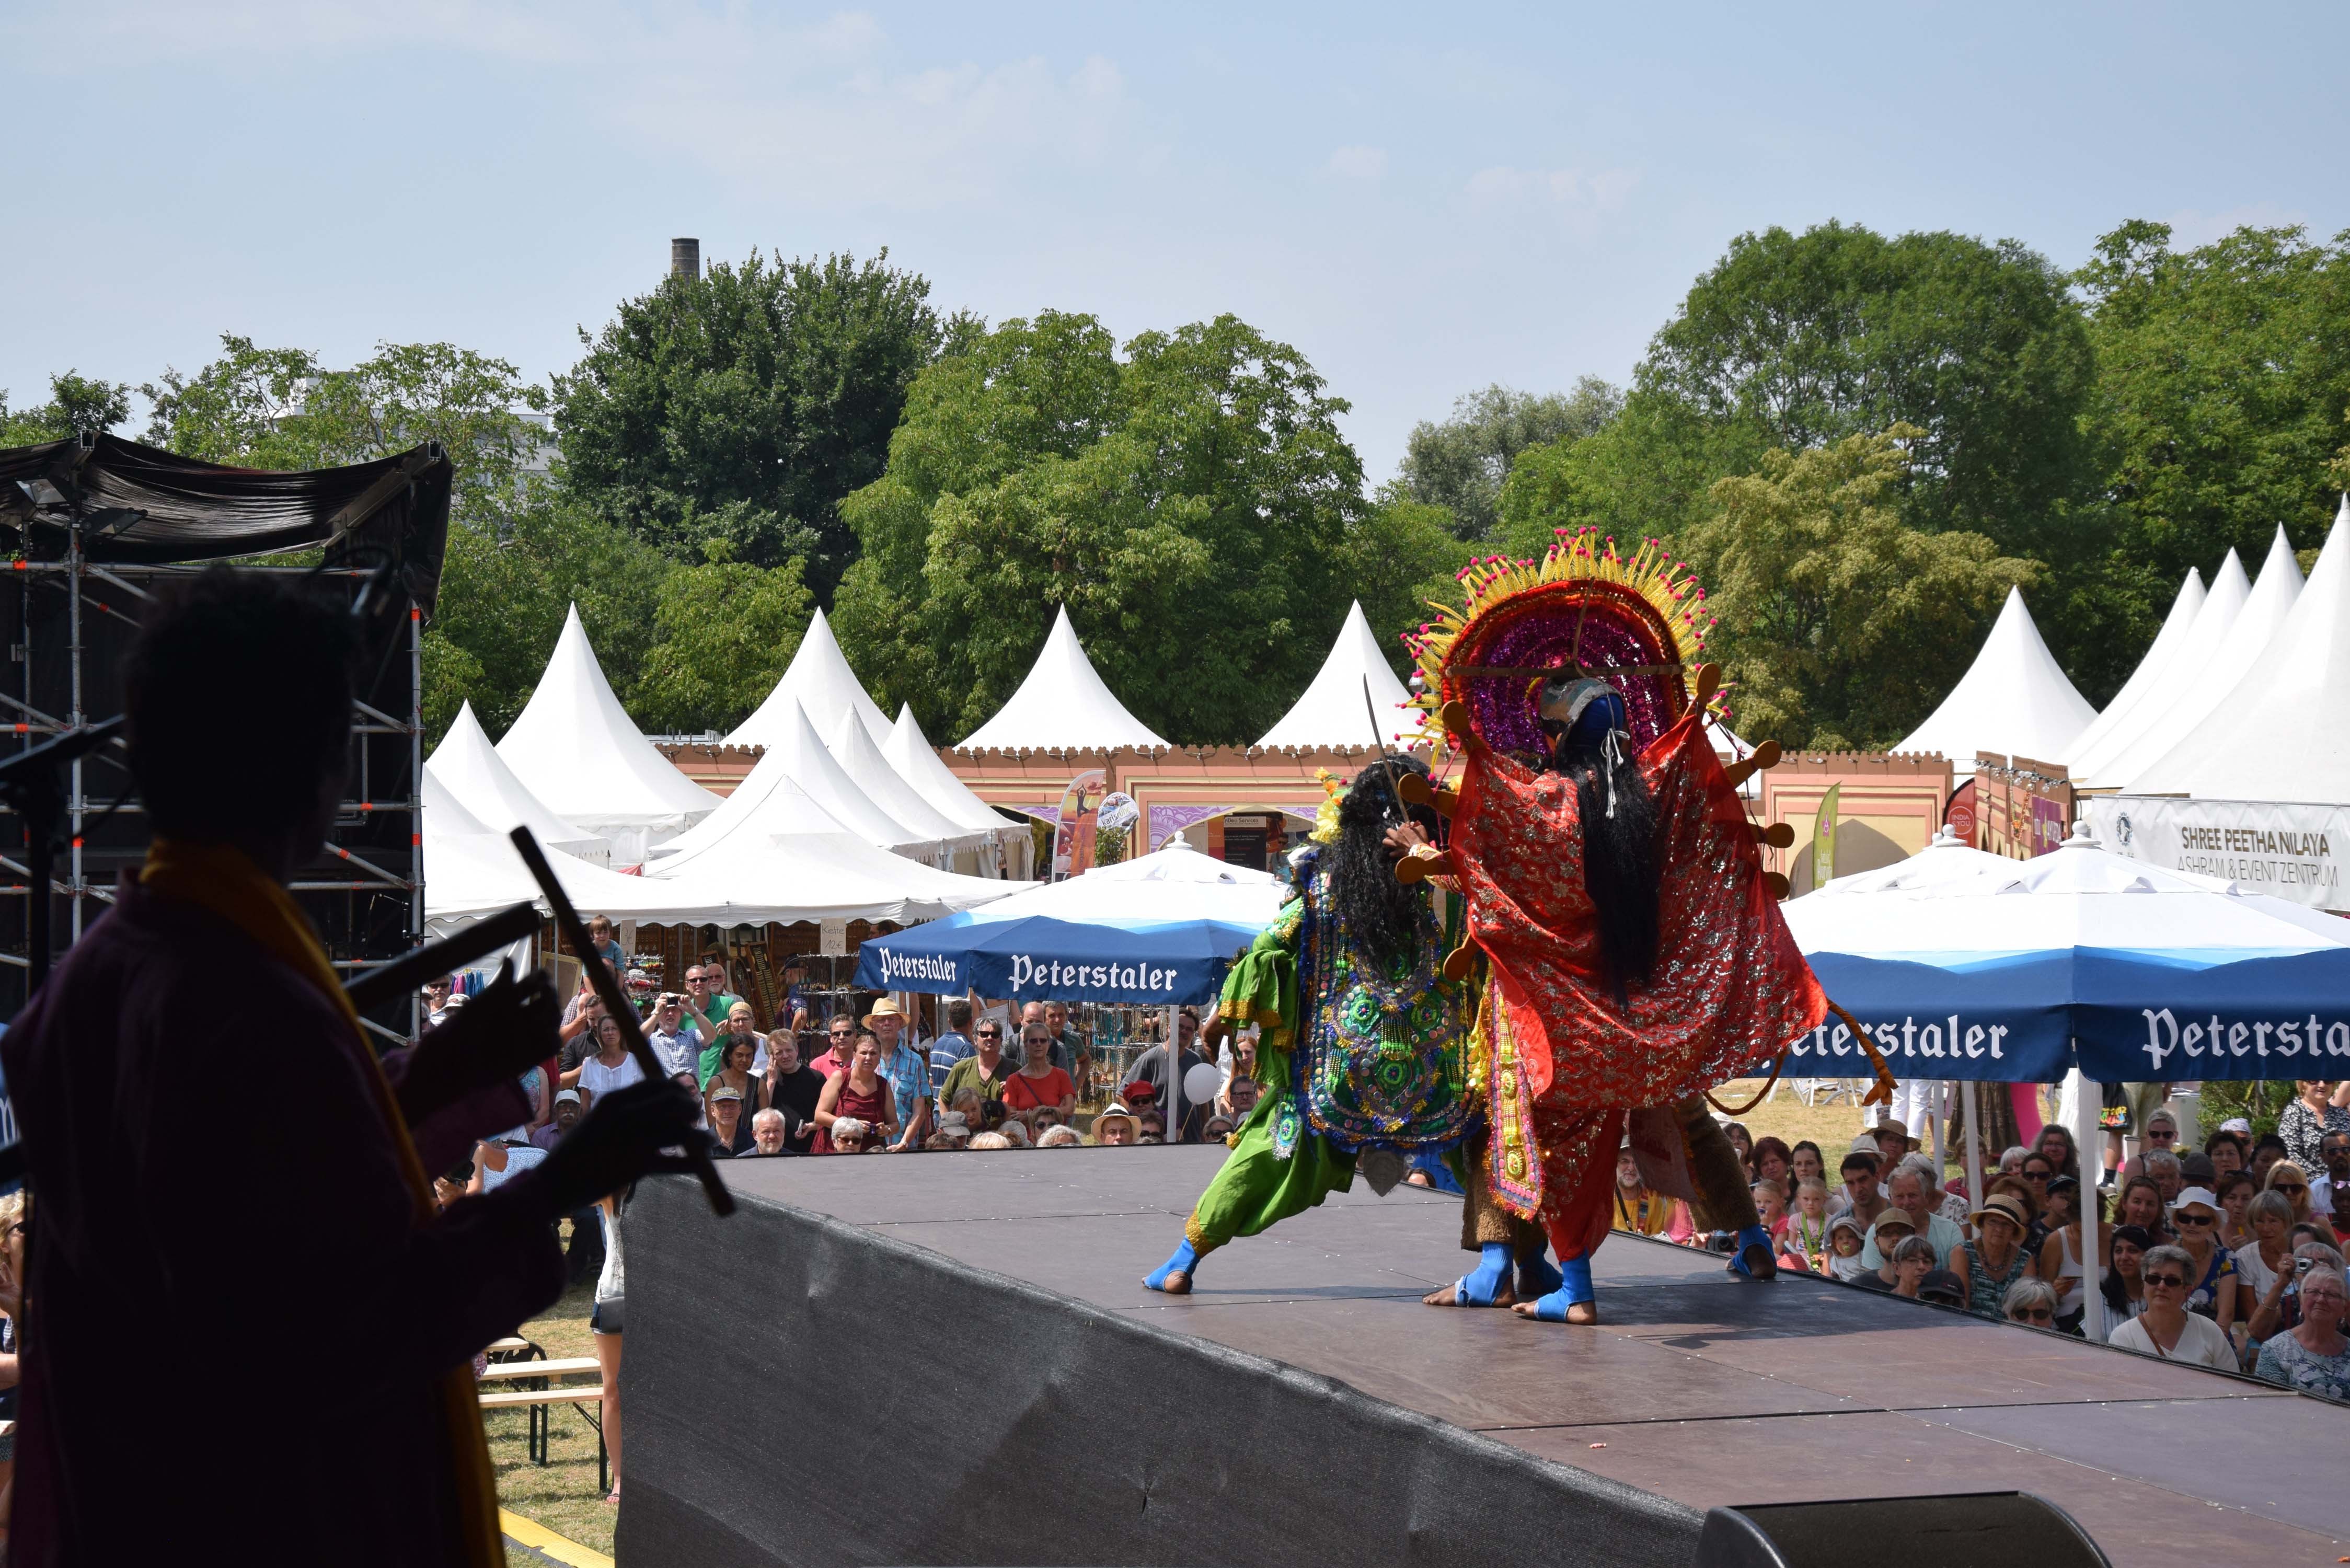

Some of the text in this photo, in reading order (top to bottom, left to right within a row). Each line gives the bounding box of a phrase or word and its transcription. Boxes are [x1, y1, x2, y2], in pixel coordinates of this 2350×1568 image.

[2182, 826, 2331, 857] SHREE PEETHA NILAYA
[2178, 856, 2339, 887] ASHRAM & EVENT ZENTRUM
[825, 939, 843, 950] 12€
[879, 947, 956, 983] Peterstaler
[1008, 954, 1177, 992] Peterstaler
[1762, 1014, 2009, 1069] eterstaler
